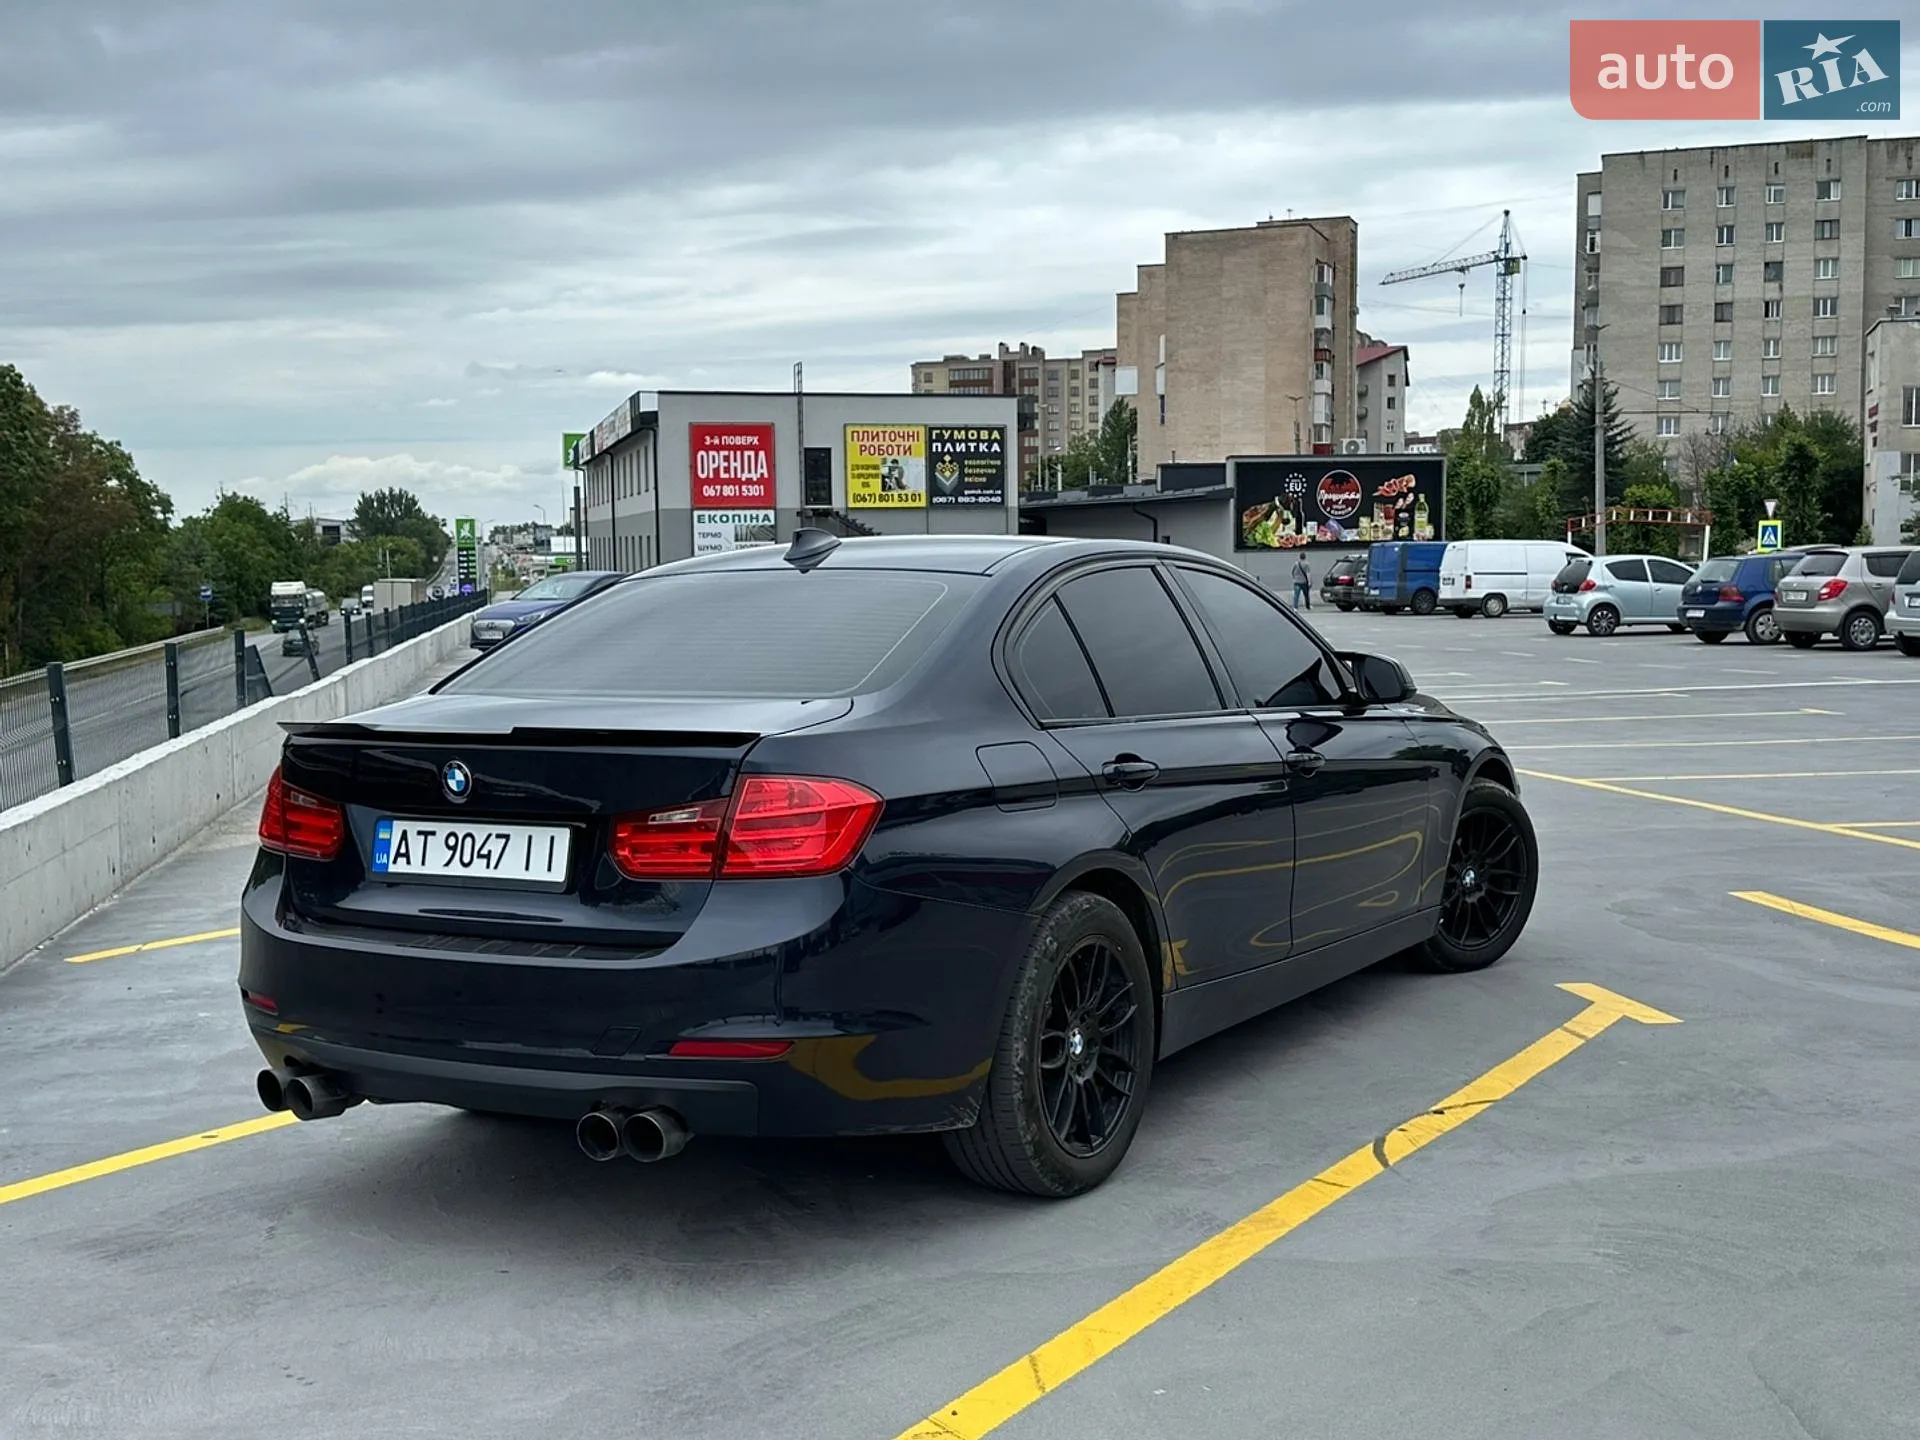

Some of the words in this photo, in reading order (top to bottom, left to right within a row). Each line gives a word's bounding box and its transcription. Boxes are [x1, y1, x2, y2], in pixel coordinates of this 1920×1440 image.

[851, 430, 921, 443] ПЛИТОЧНІ
[932, 430, 1001, 440] ГУМОВА
[721, 436, 760, 446] ПОВЕРХ
[859, 444, 912, 456] РОБОТИ
[932, 442, 1001, 453] ПЛИТКА
[697, 450, 769, 482] ОРЕНДА
[702, 485, 721, 497] 067
[722, 485, 740, 497] 801
[741, 485, 765, 497] 5301
[1289, 483, 1302, 491] EU
[853, 493, 877, 504] (067)
[878, 493, 894, 503] 801
[697, 513, 772, 524] ЕКОПІНА
[392, 829, 437, 866] AT
[443, 830, 511, 870] 9047
[375, 852, 388, 865] UA
